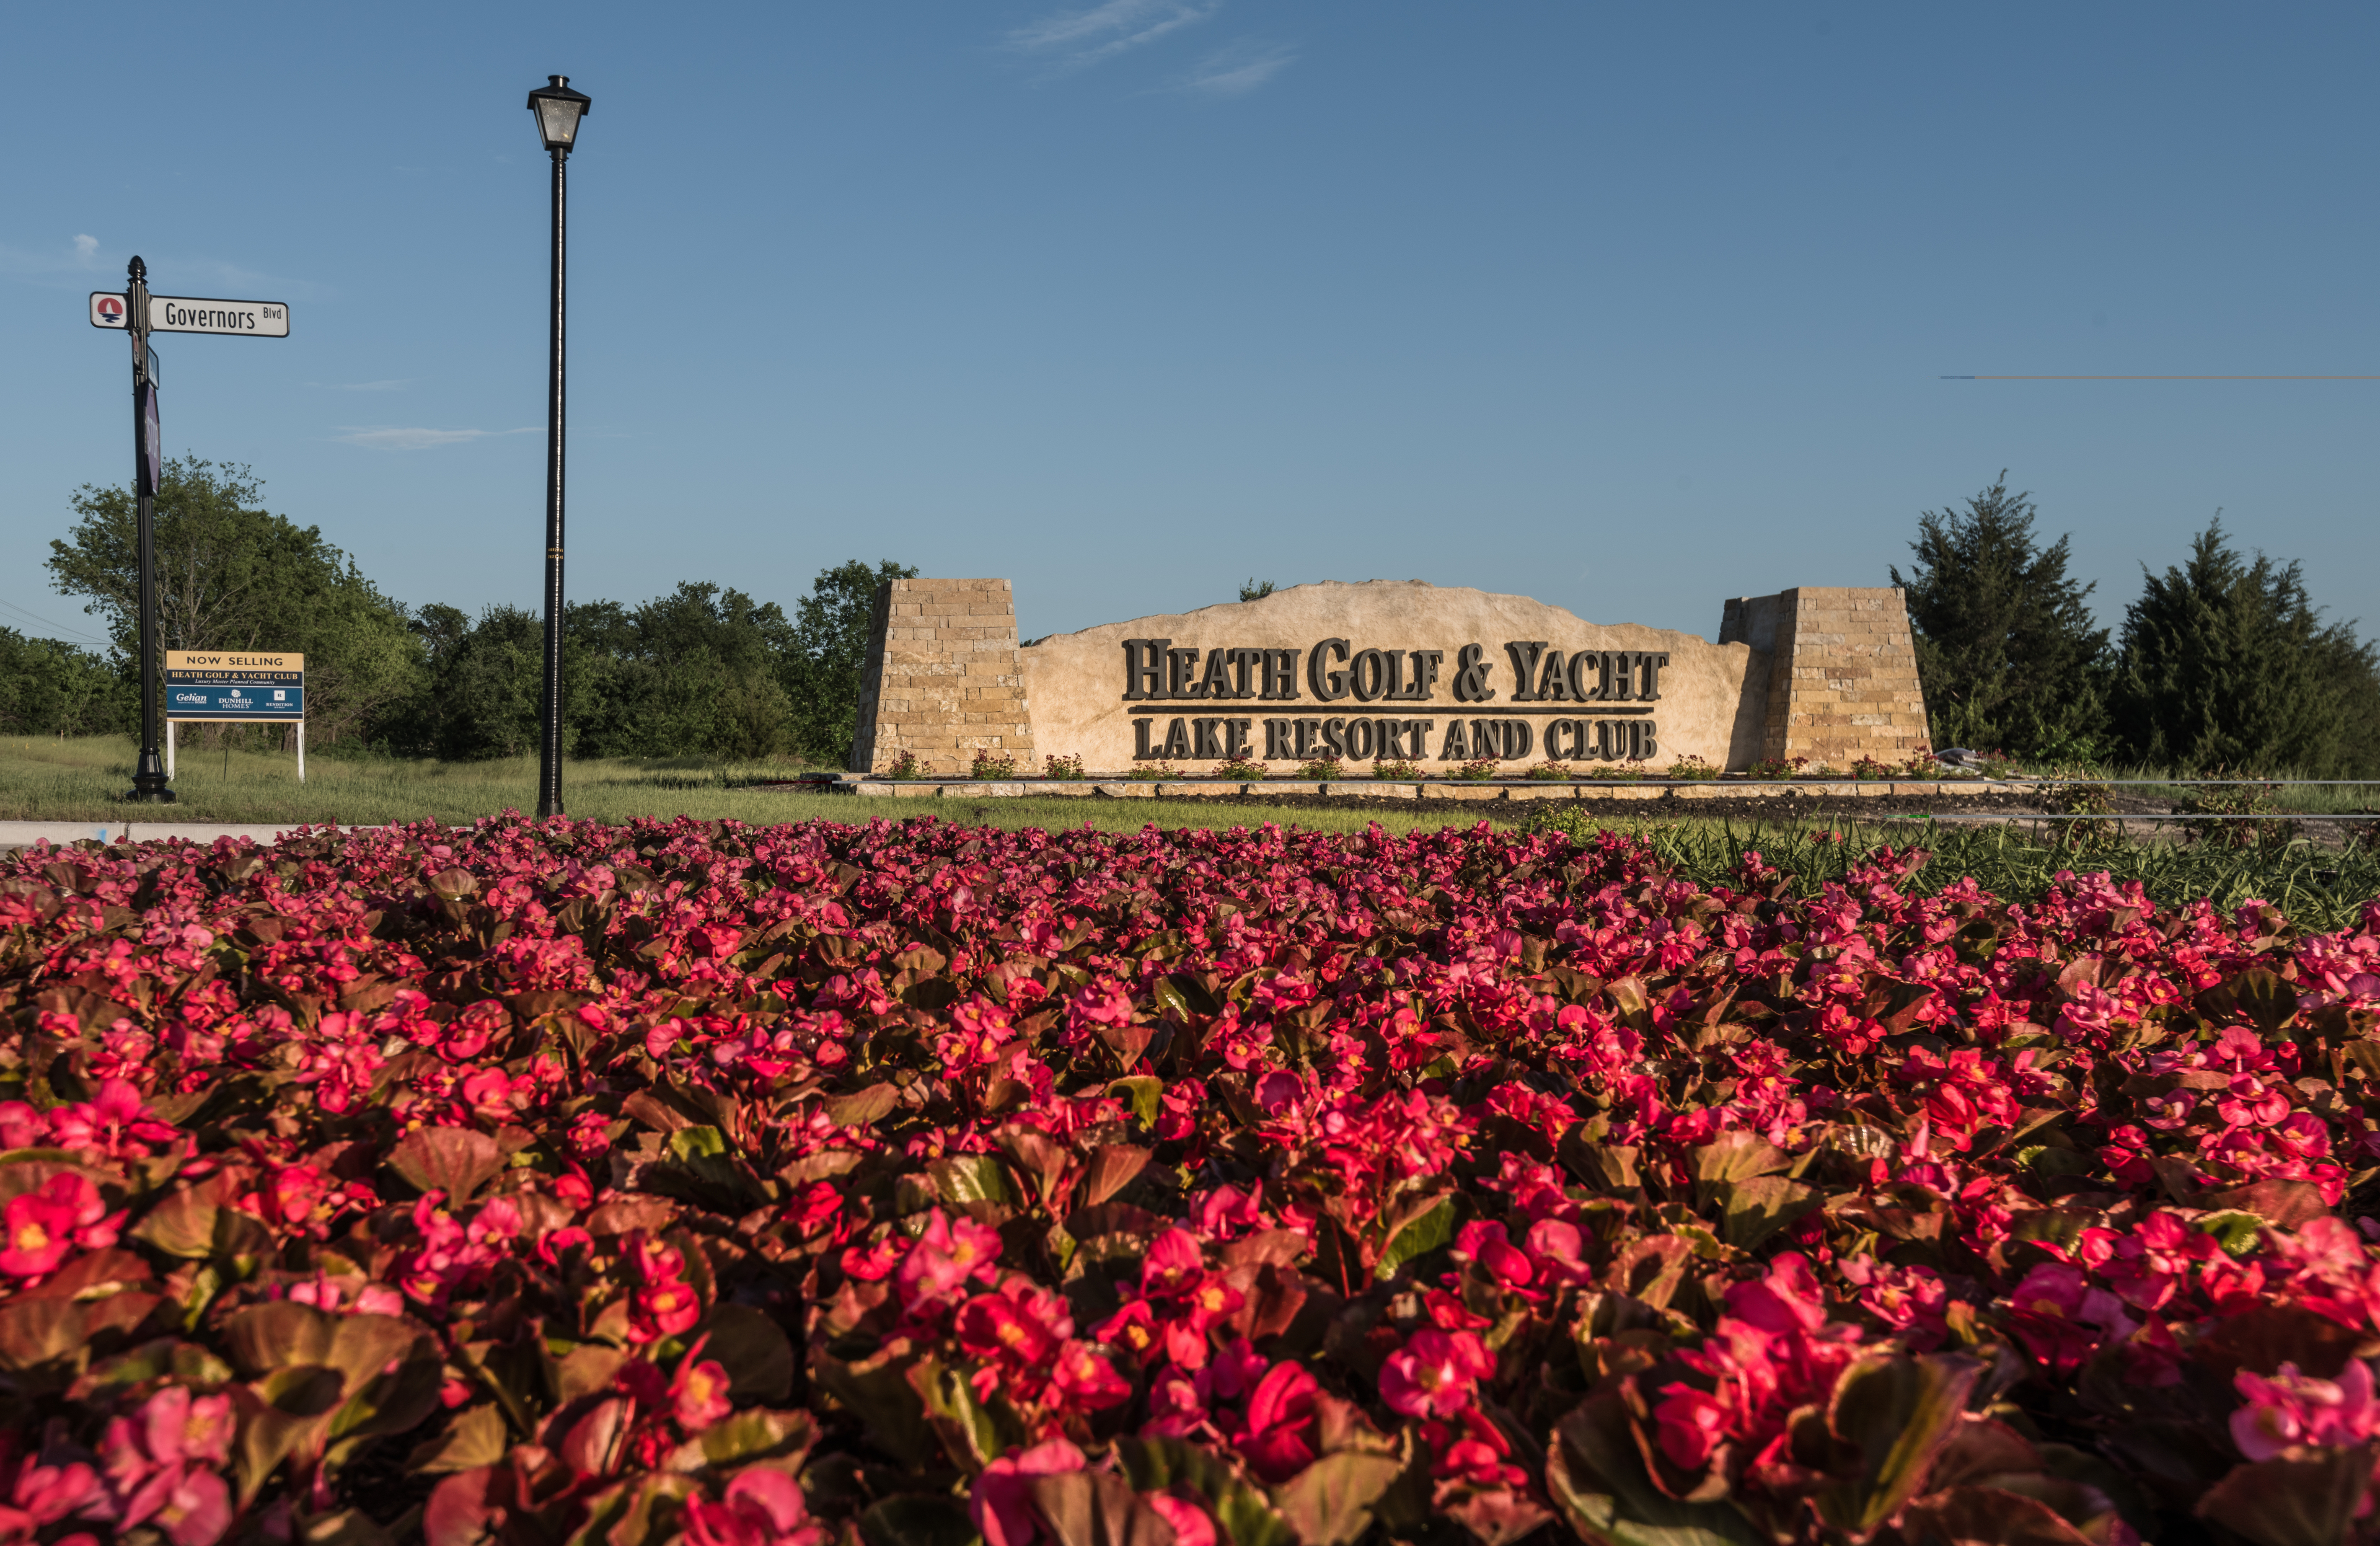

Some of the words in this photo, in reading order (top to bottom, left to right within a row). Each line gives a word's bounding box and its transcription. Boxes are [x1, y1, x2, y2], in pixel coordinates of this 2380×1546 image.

[166, 303, 255, 329] Governors
[263, 307, 281, 319] Blvd
[147, 415, 159, 460] STOP
[187, 656, 221, 665] NOW
[228, 657, 283, 666] SELLING
[1127, 638, 1302, 700] HEATH
[1314, 637, 1444, 700] GOLF
[1460, 642, 1496, 700] &
[1510, 641, 1670, 701] YACHT
[1138, 717, 1253, 759] LAKE
[1269, 717, 1434, 759] RESORT
[1447, 718, 1534, 759] AND
[1551, 717, 1657, 760] CLUB
